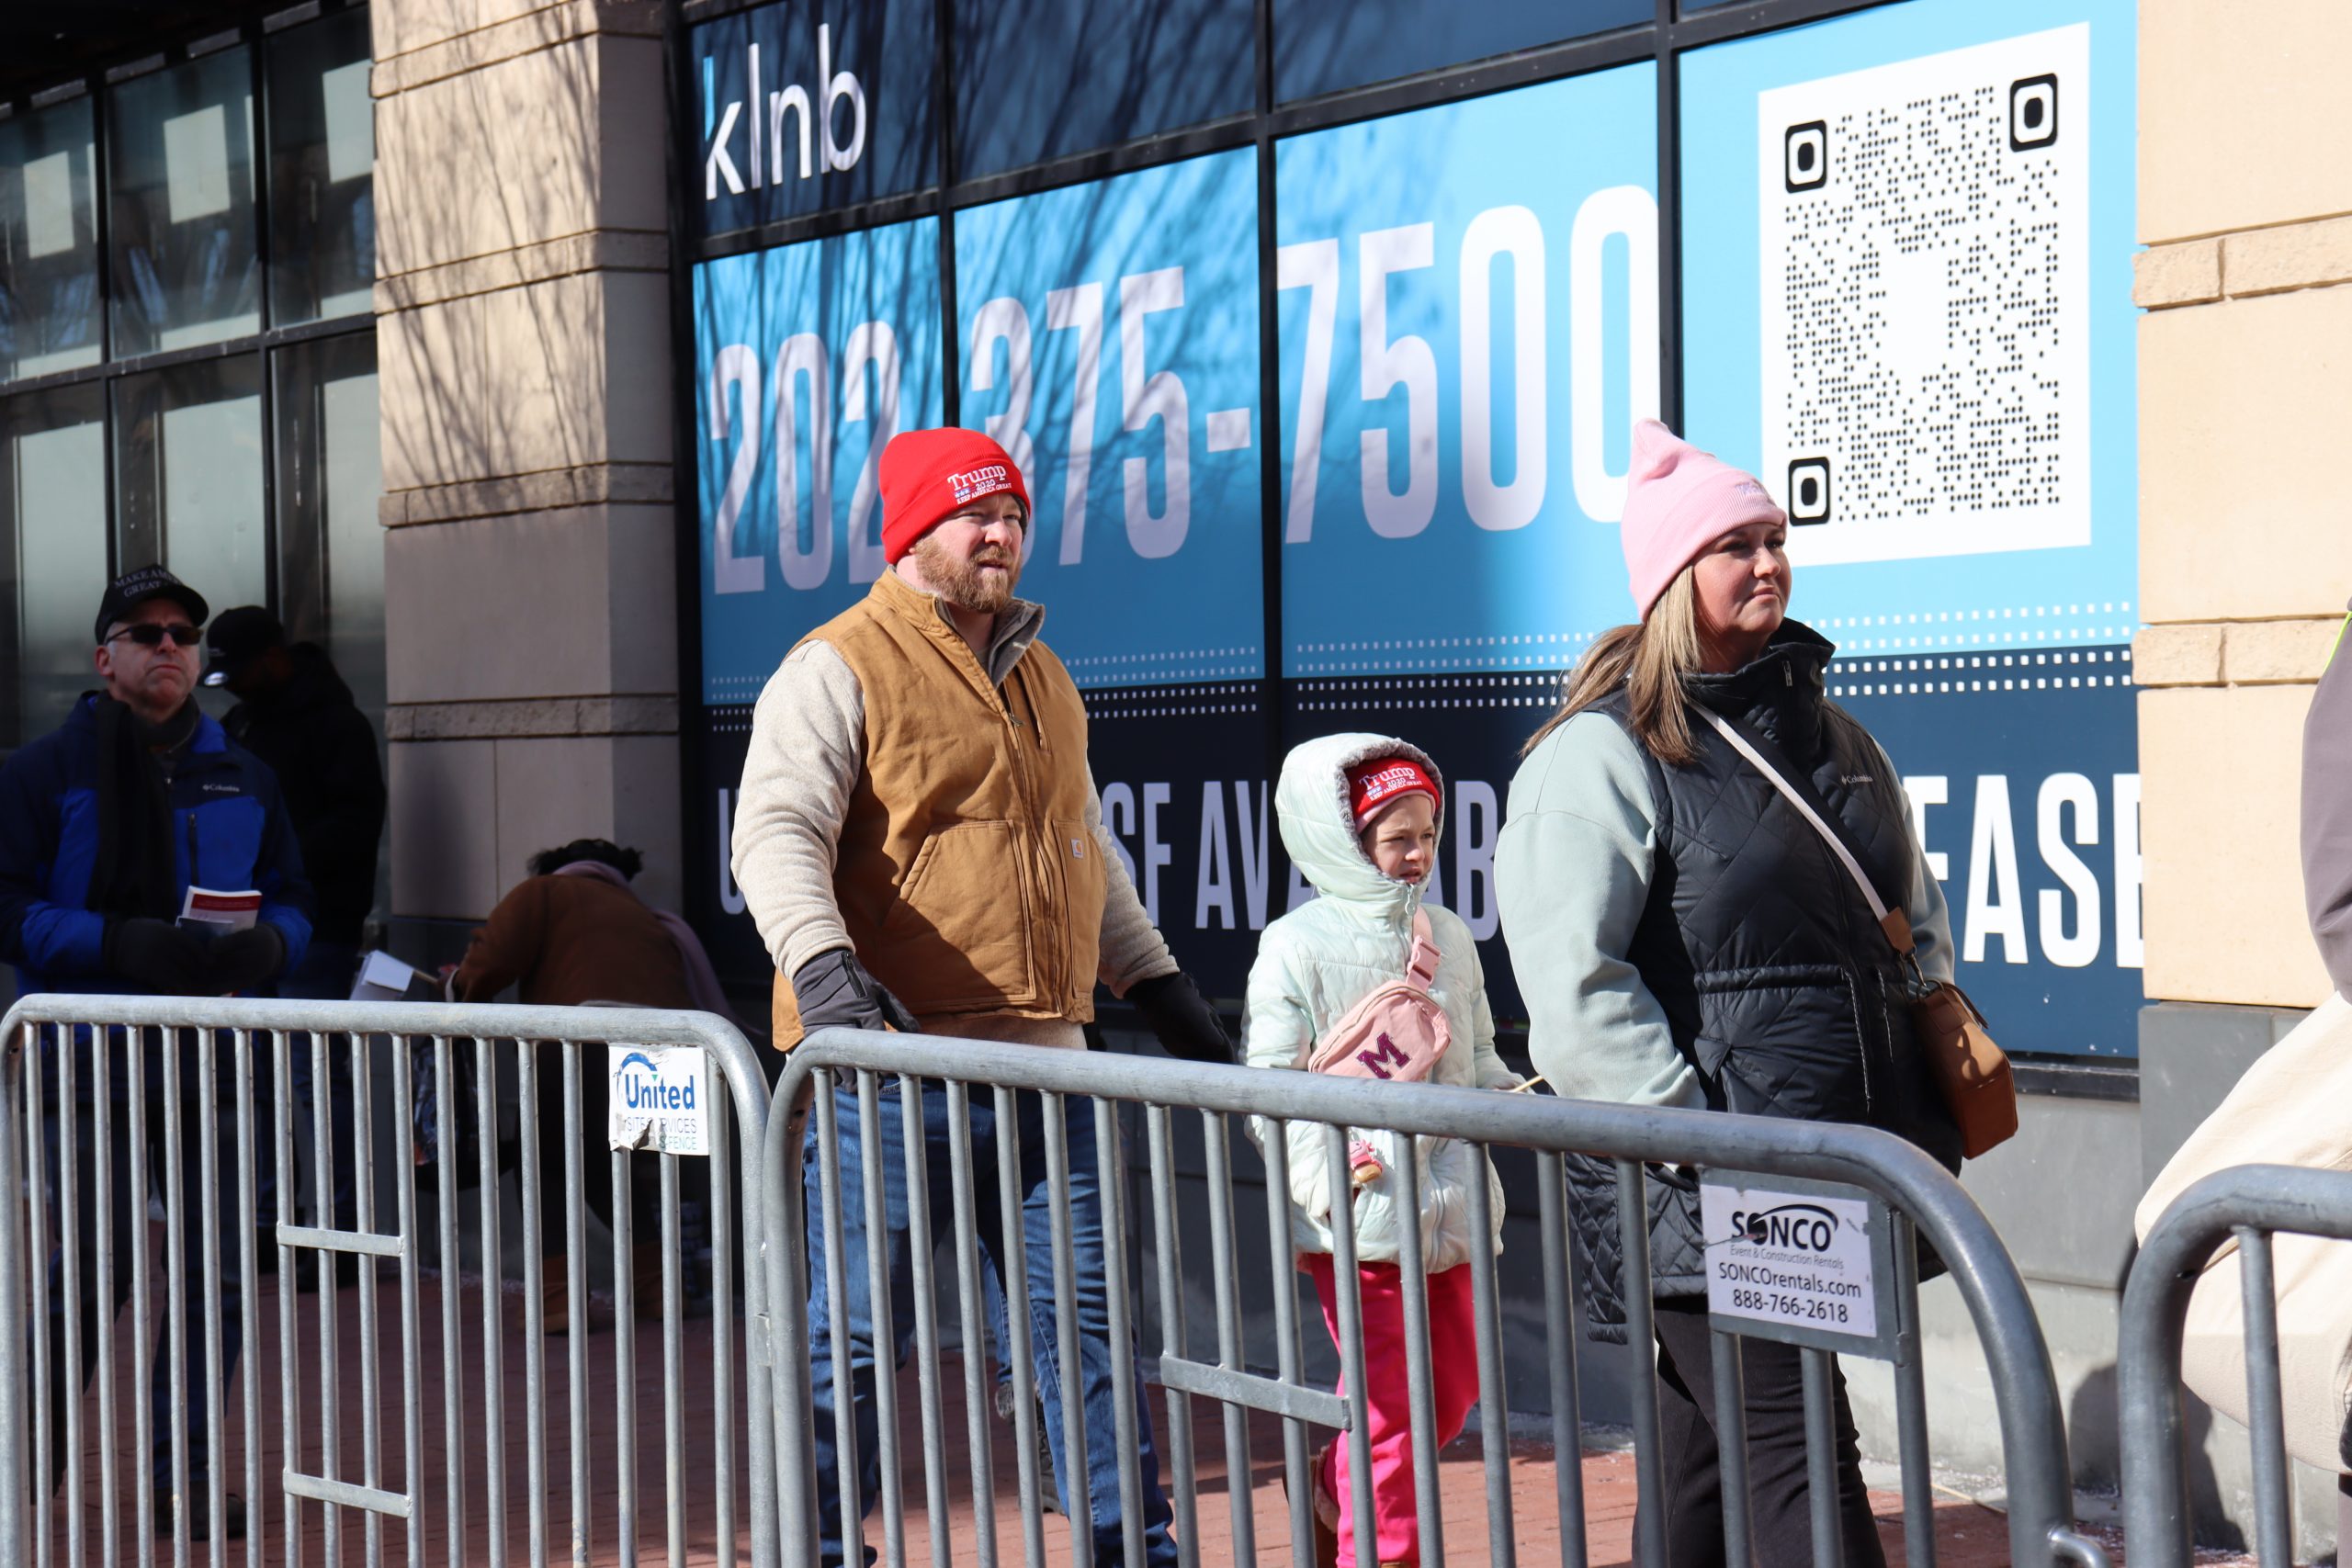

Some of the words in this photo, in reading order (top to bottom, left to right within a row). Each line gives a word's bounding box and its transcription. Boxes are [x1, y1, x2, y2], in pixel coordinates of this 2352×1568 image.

[703, 23, 865, 200] klnb
[947, 465, 1007, 491] Trump
[975, 479, 996, 491] 2020
[1359, 767, 1416, 791] Trump
[1356, 1032, 1411, 1079] M
[625, 1073, 696, 1111] United
[1731, 1211, 1831, 1253] SONCO
[1729, 1244, 1752, 1257] Event
[1752, 1248, 1759, 1258] &
[1760, 1247, 1813, 1265] Construction
[1814, 1255, 1845, 1270] Rentals
[1718, 1261, 1862, 1299] SONCOrentals.com
[1733, 1289, 1849, 1324] 888-766-2618
